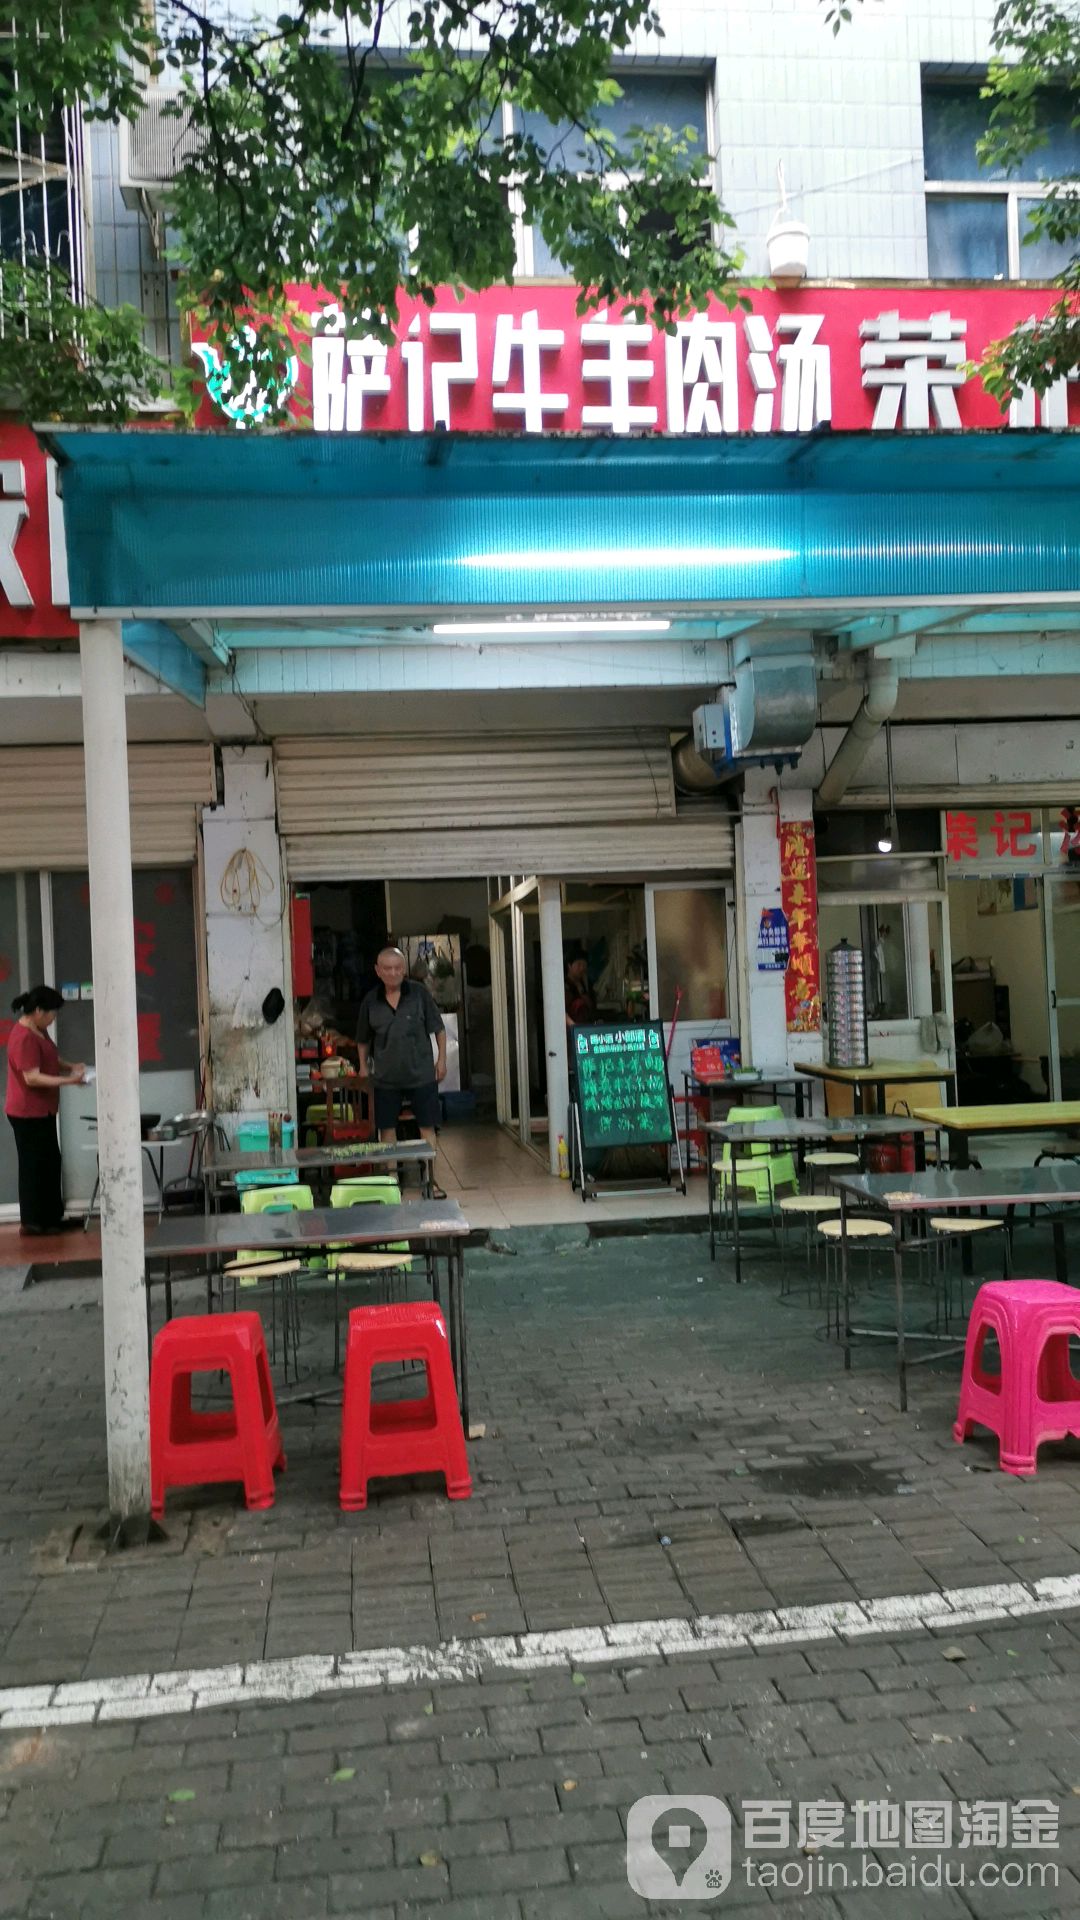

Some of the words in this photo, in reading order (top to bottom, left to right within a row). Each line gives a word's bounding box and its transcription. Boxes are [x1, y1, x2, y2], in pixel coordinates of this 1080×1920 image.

[311, 304, 832, 433] 萨记牛羊肉汤
